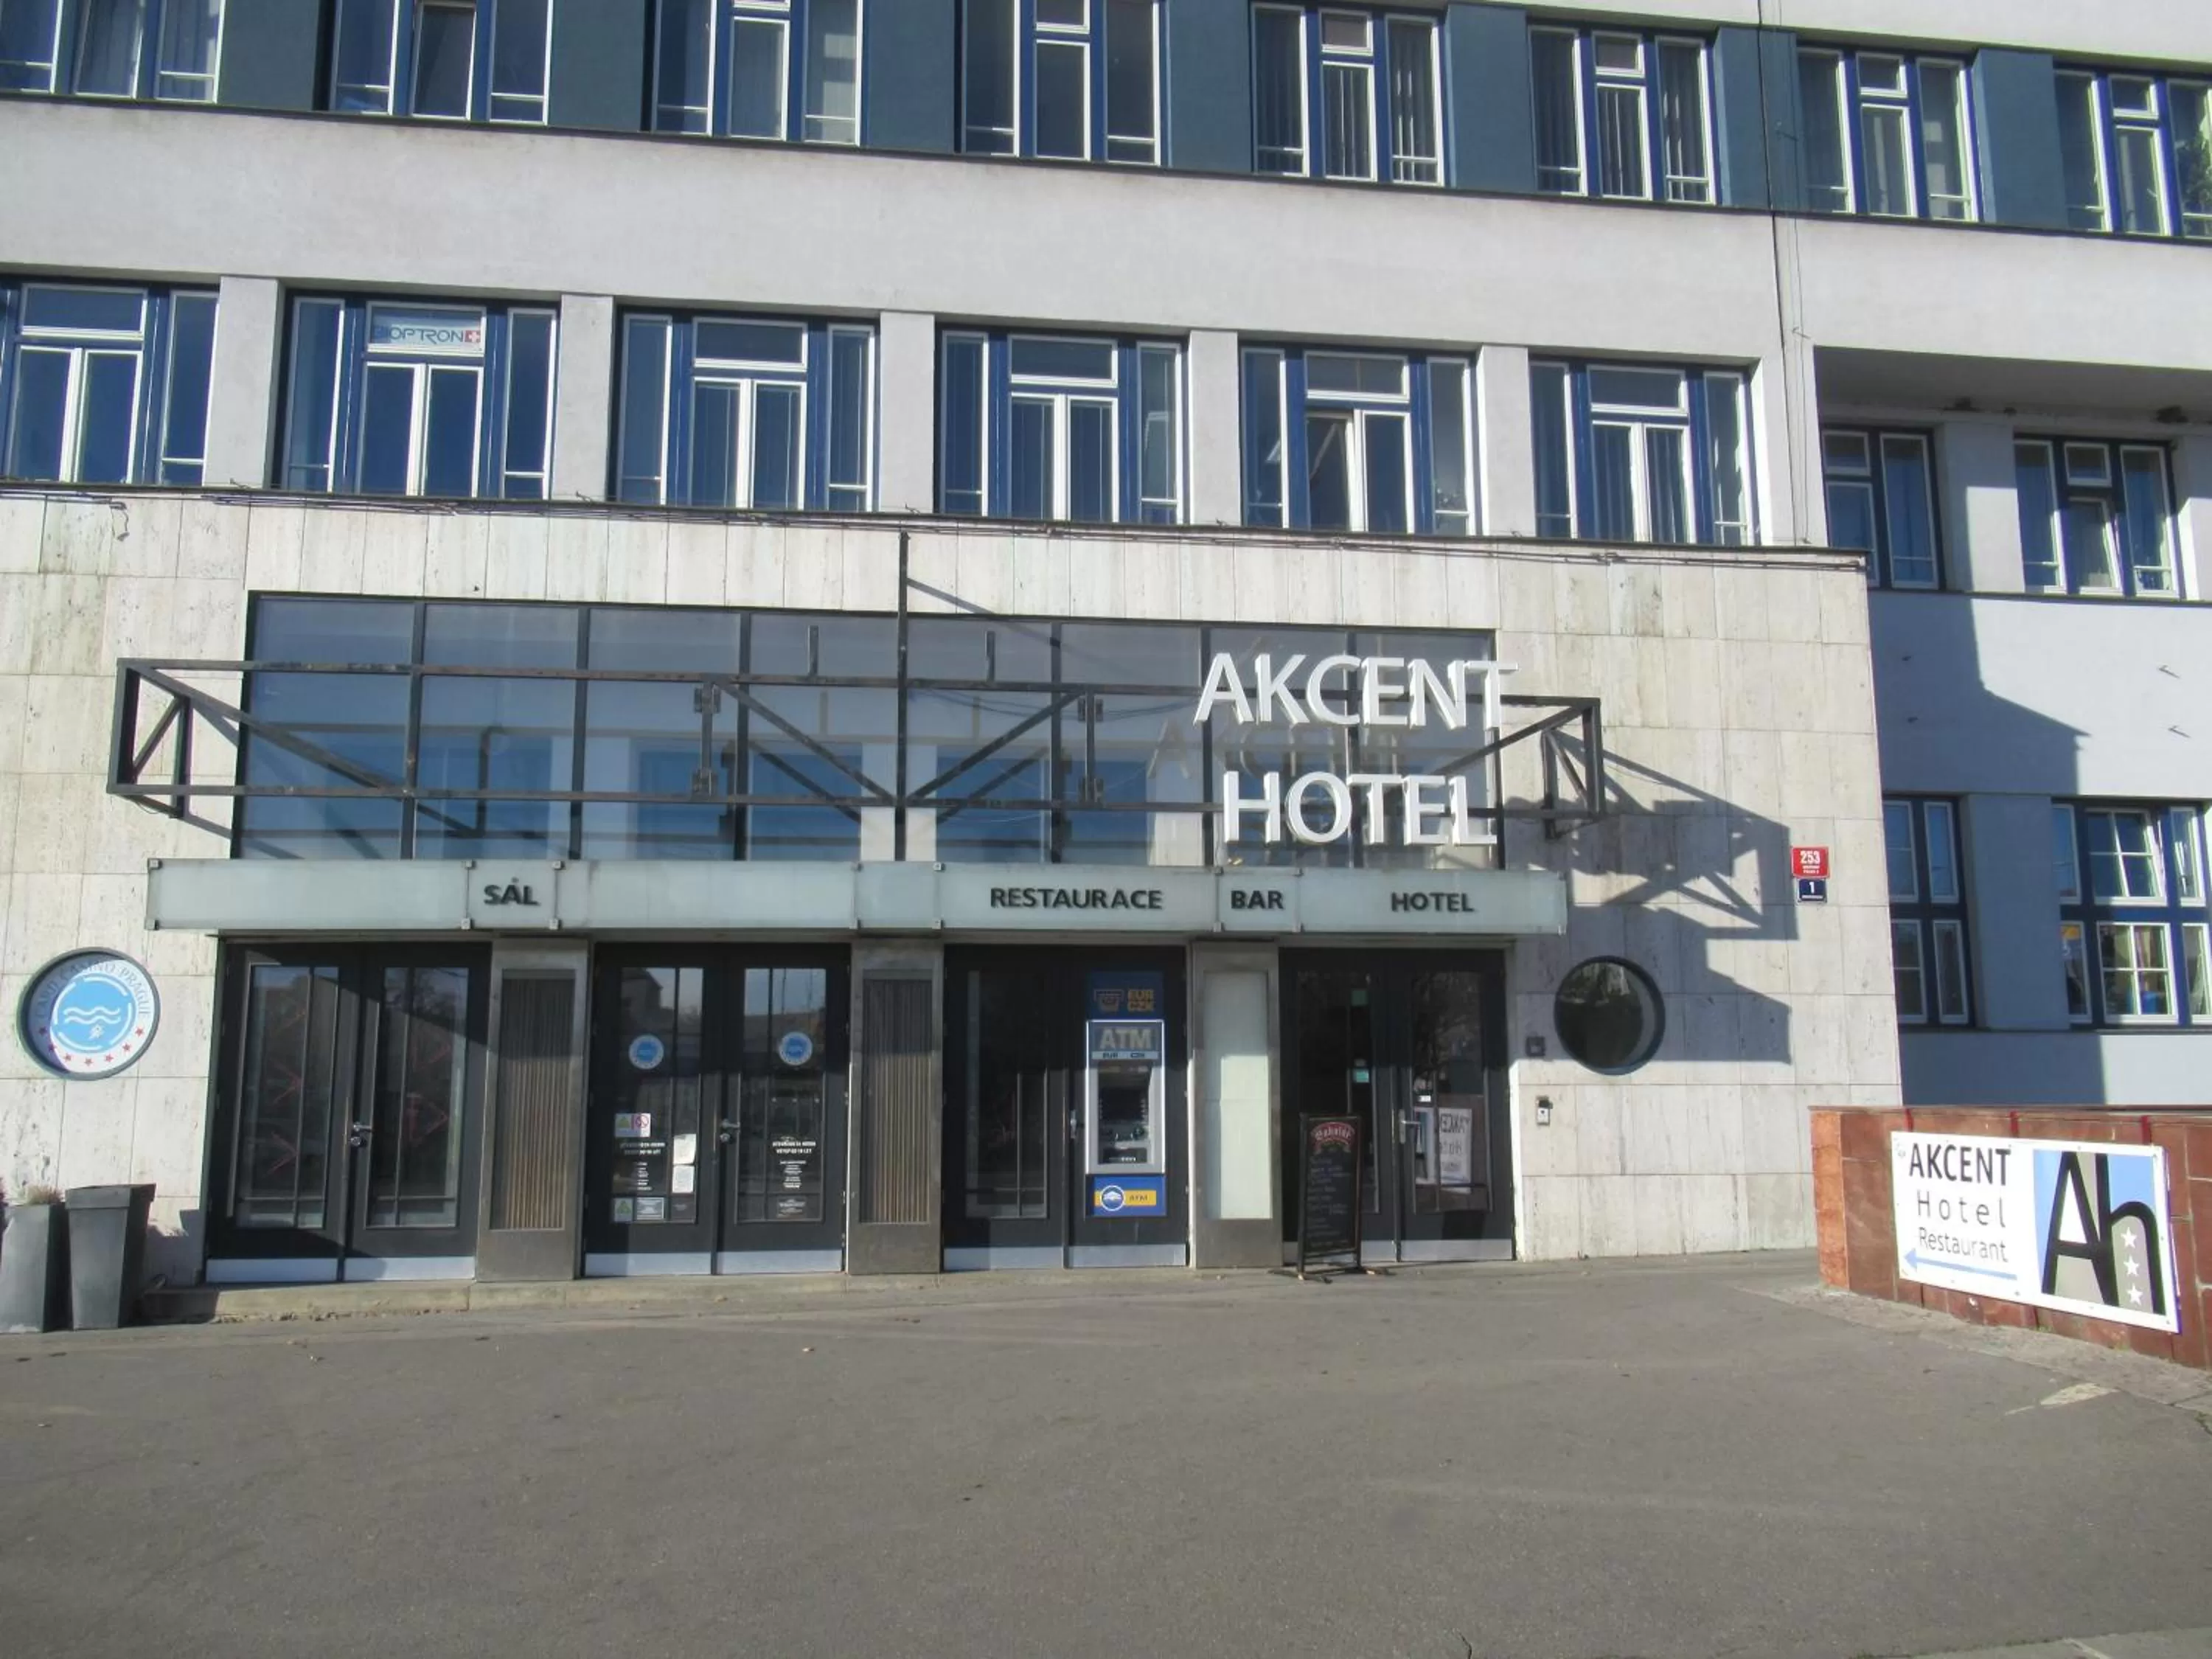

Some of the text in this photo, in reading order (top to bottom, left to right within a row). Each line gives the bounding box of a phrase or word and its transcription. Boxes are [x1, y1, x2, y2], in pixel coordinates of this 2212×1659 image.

[1193, 652, 1518, 731] AKCENT
[1223, 771, 1497, 845] HOTEL
[1800, 850, 1820, 865] 253
[990, 888, 1163, 910] RESTAURACE
[1231, 891, 1284, 910] BAR
[1809, 881, 1815, 894] 1
[1391, 892, 1475, 913] HOTEL
[119, 967, 151, 1017] PRAGUE
[1099, 1028, 1152, 1050] ATM
[1908, 1143, 2011, 1186] AKCENT
[1917, 1190, 2006, 1228] Hotel
[1919, 1227, 2008, 1262] Restaurant
